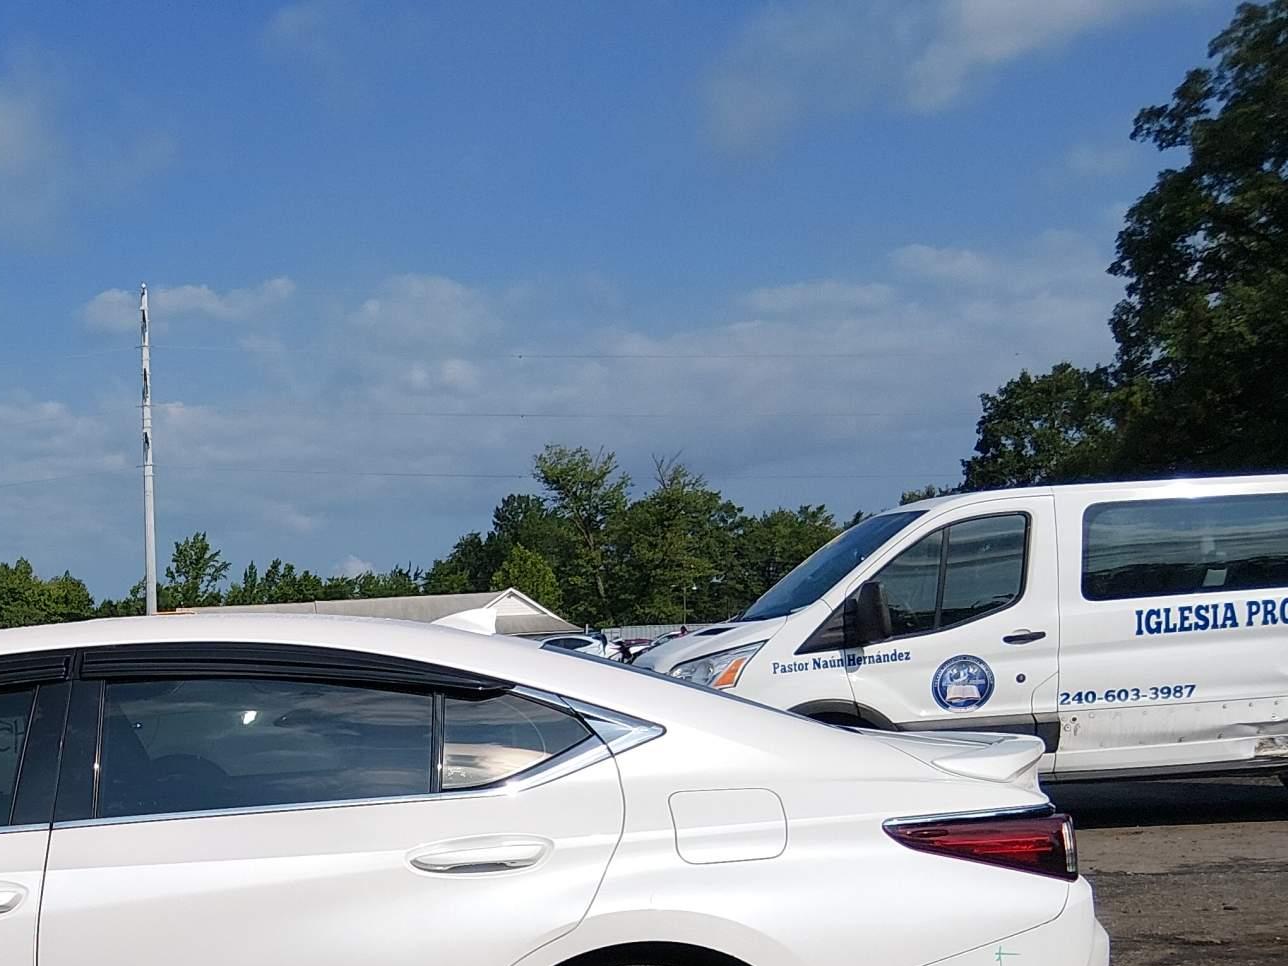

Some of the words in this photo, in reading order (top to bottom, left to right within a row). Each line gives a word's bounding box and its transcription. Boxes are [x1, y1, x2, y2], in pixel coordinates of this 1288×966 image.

[1135, 602, 1239, 636] IGLESIA
[772, 662, 809, 674] Pastor
[812, 656, 844, 670] Naún
[847, 648, 911, 666] Hernández
[1059, 684, 1196, 705] 240-603-3987
